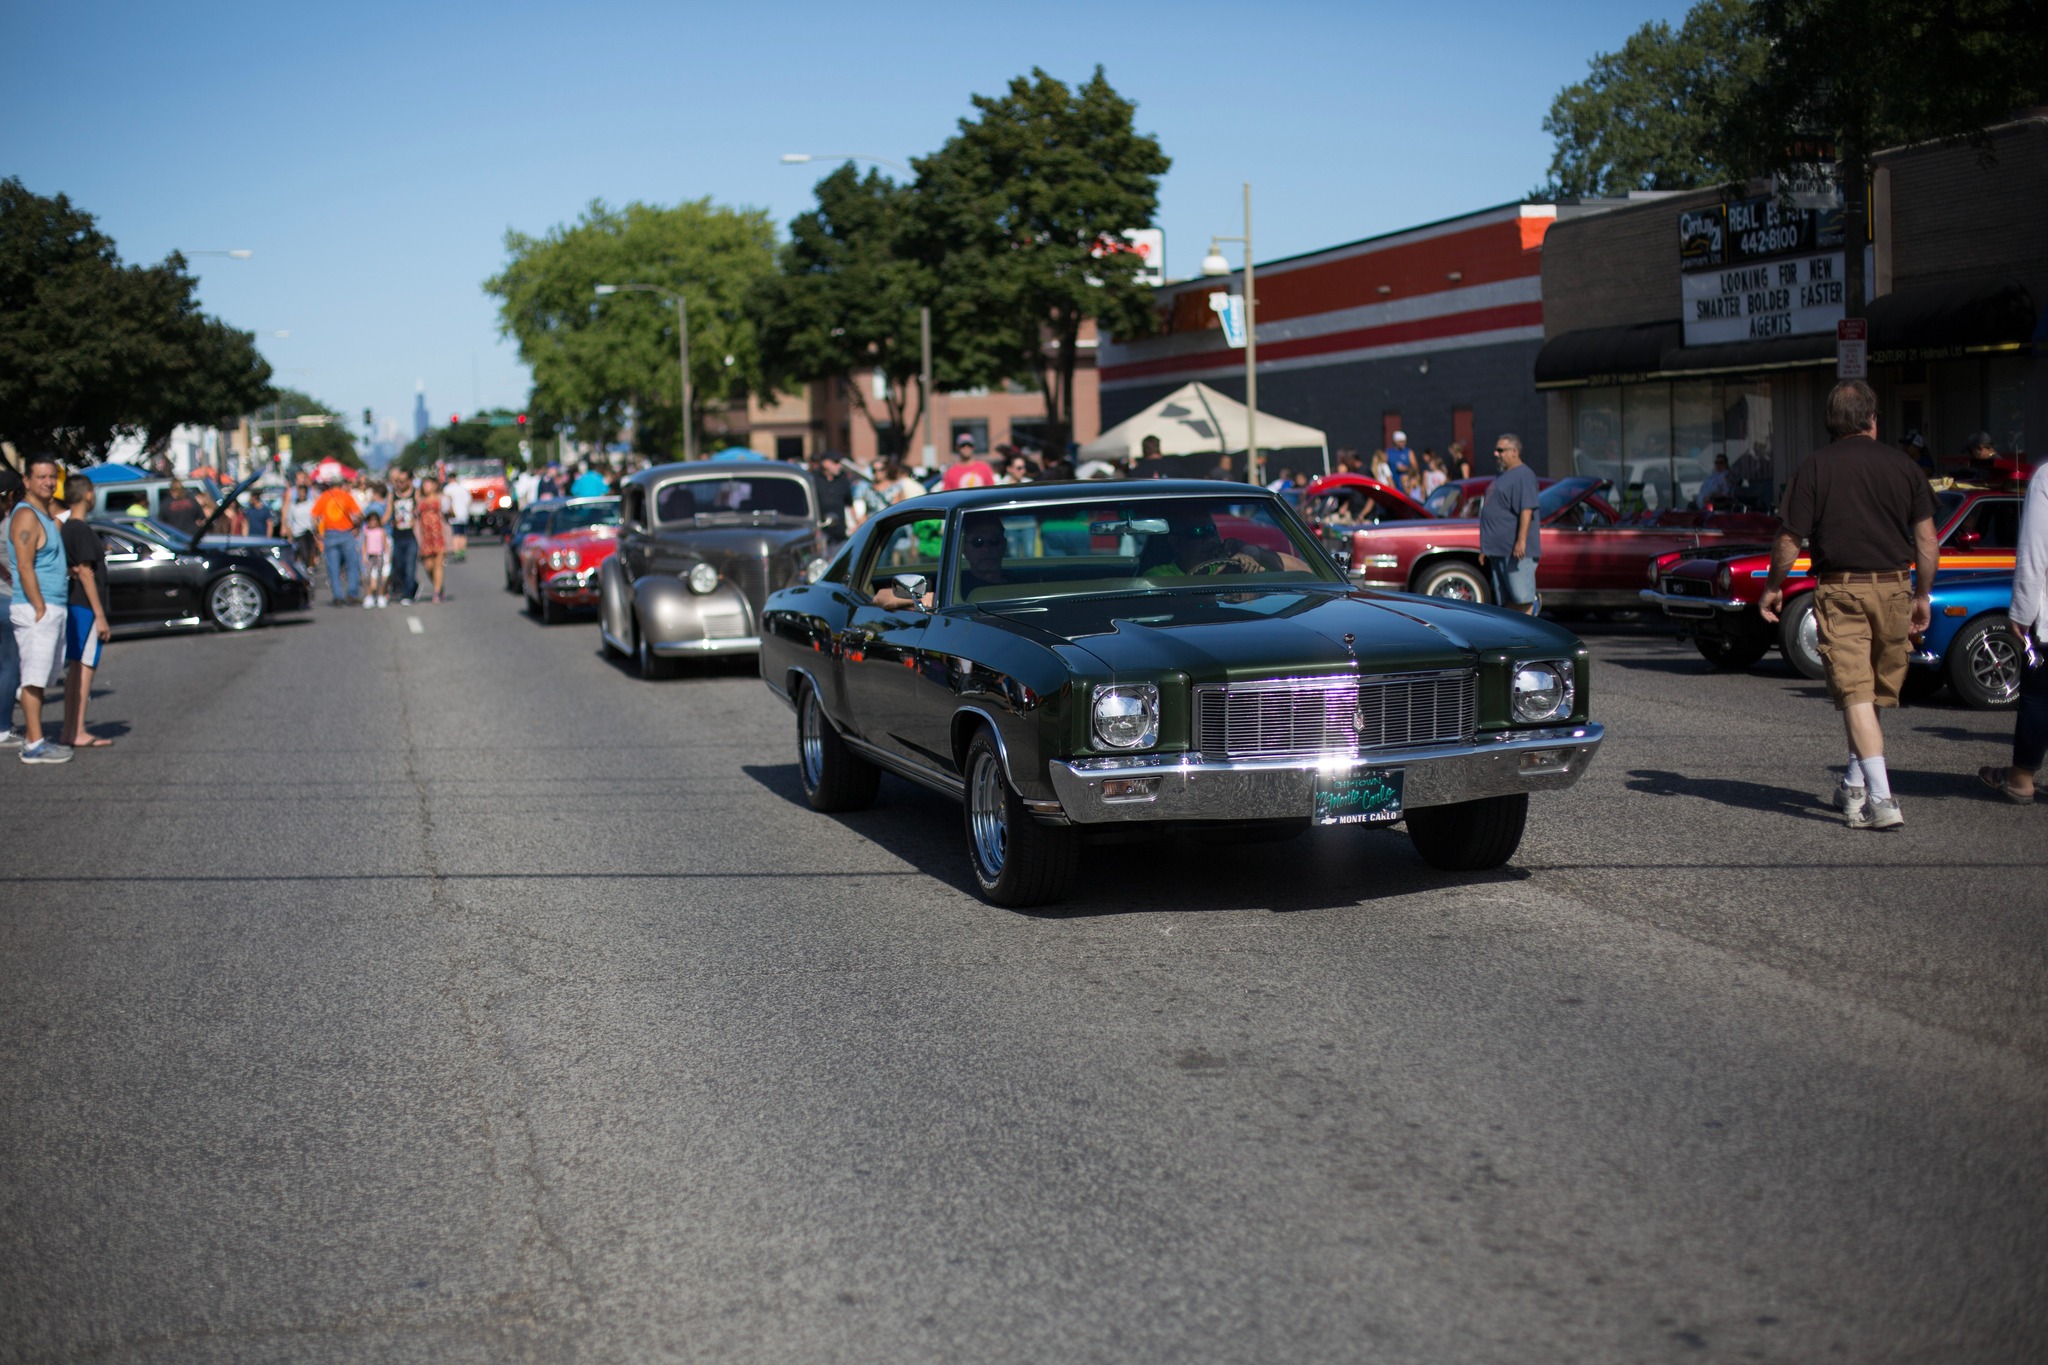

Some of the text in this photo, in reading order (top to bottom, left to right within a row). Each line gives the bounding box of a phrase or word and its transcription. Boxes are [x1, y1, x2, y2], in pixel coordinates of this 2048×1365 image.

[1728, 204, 1760, 233] REAL
[1720, 258, 1832, 295] LOOKING FOR NEW
[1697, 282, 1842, 320] SMARTER BOLDER FASTER
[1750, 313, 1791, 338] AGENTS
[1339, 814, 1367, 824] MONTE
